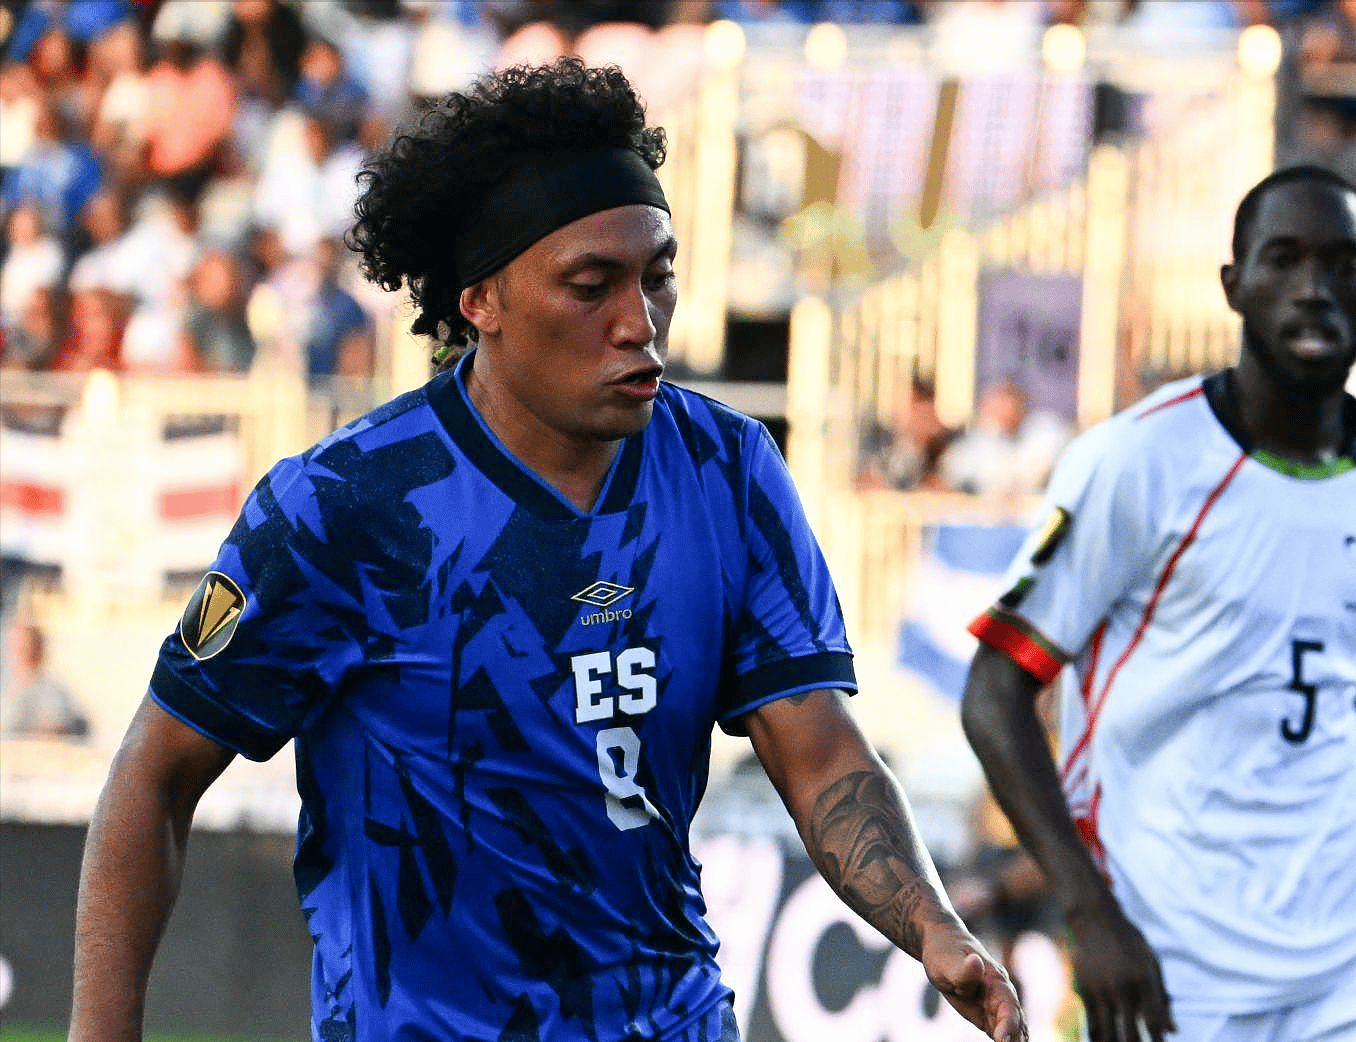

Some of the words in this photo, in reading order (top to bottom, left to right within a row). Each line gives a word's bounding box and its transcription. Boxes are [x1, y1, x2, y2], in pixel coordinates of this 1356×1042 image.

[580, 608, 633, 626] umbro
[571, 646, 658, 724] ES
[1280, 638, 1325, 745] 5
[597, 727, 652, 832] 8
